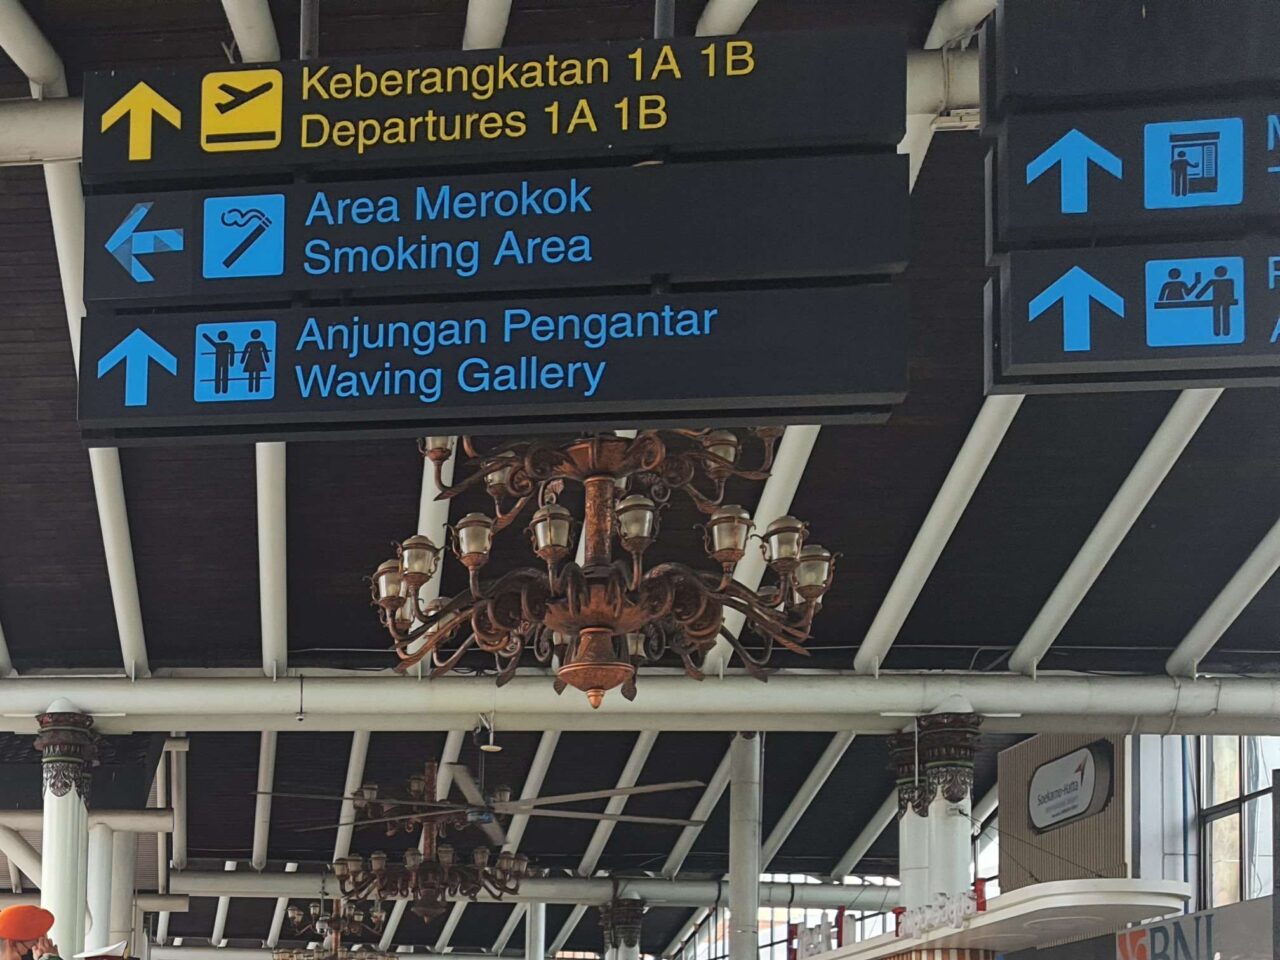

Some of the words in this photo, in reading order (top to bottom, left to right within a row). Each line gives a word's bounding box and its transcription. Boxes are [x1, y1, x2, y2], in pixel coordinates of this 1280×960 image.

[302, 56, 609, 100] Keberangkatan
[628, 45, 681, 81] 1A
[703, 40, 755, 76] 1B
[301, 111, 527, 154] Departures
[545, 98, 597, 134] 1A
[616, 95, 667, 130] 1B
[305, 191, 400, 226] Area
[415, 178, 592, 222] Merokok
[303, 234, 480, 278] Smoking
[494, 230, 592, 267] Area
[296, 316, 487, 360] Anjungan
[502, 304, 718, 350] Pengantar
[296, 362, 444, 404] Waving
[457, 356, 607, 398] Gallery
